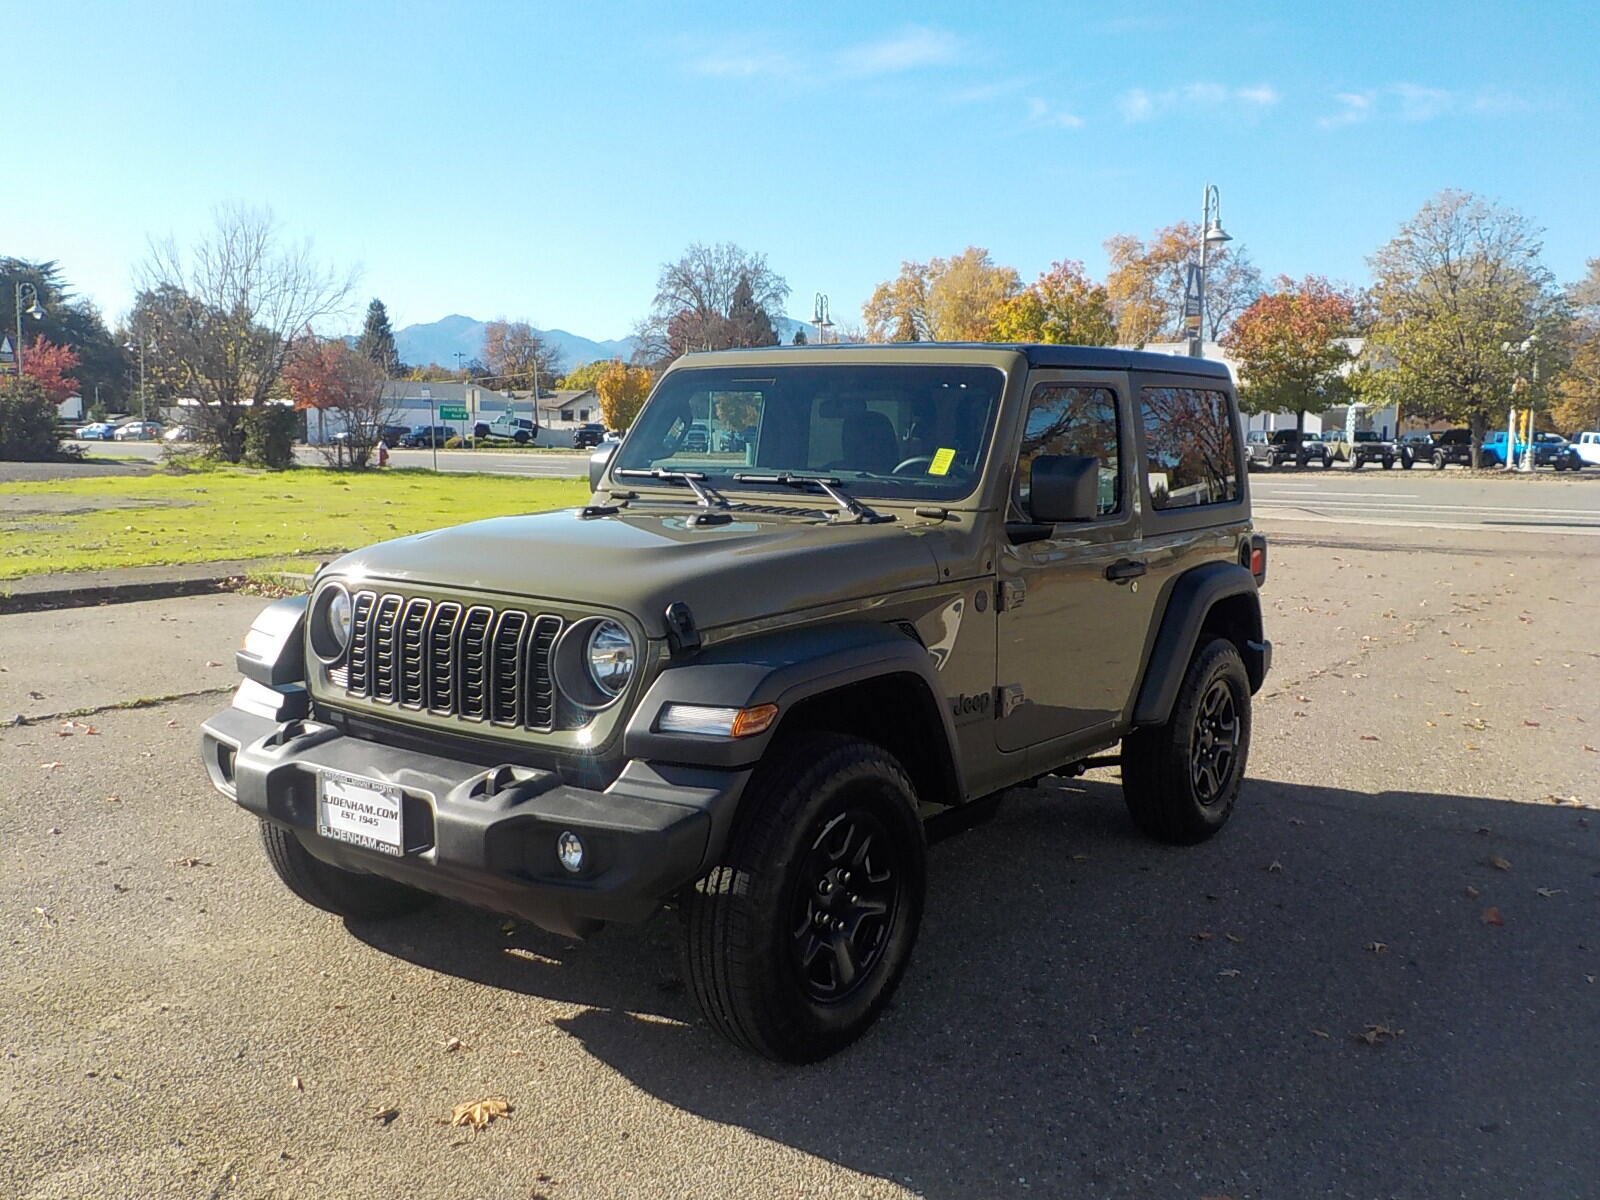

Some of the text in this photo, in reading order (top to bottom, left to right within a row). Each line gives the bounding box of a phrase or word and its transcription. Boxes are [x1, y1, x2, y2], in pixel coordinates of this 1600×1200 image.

[953, 692, 990, 716] Jeep
[321, 793, 399, 821] SJDENHAM.COM
[340, 810, 380, 827] EST. 1945
[320, 825, 399, 856] SJDENHAM.com
